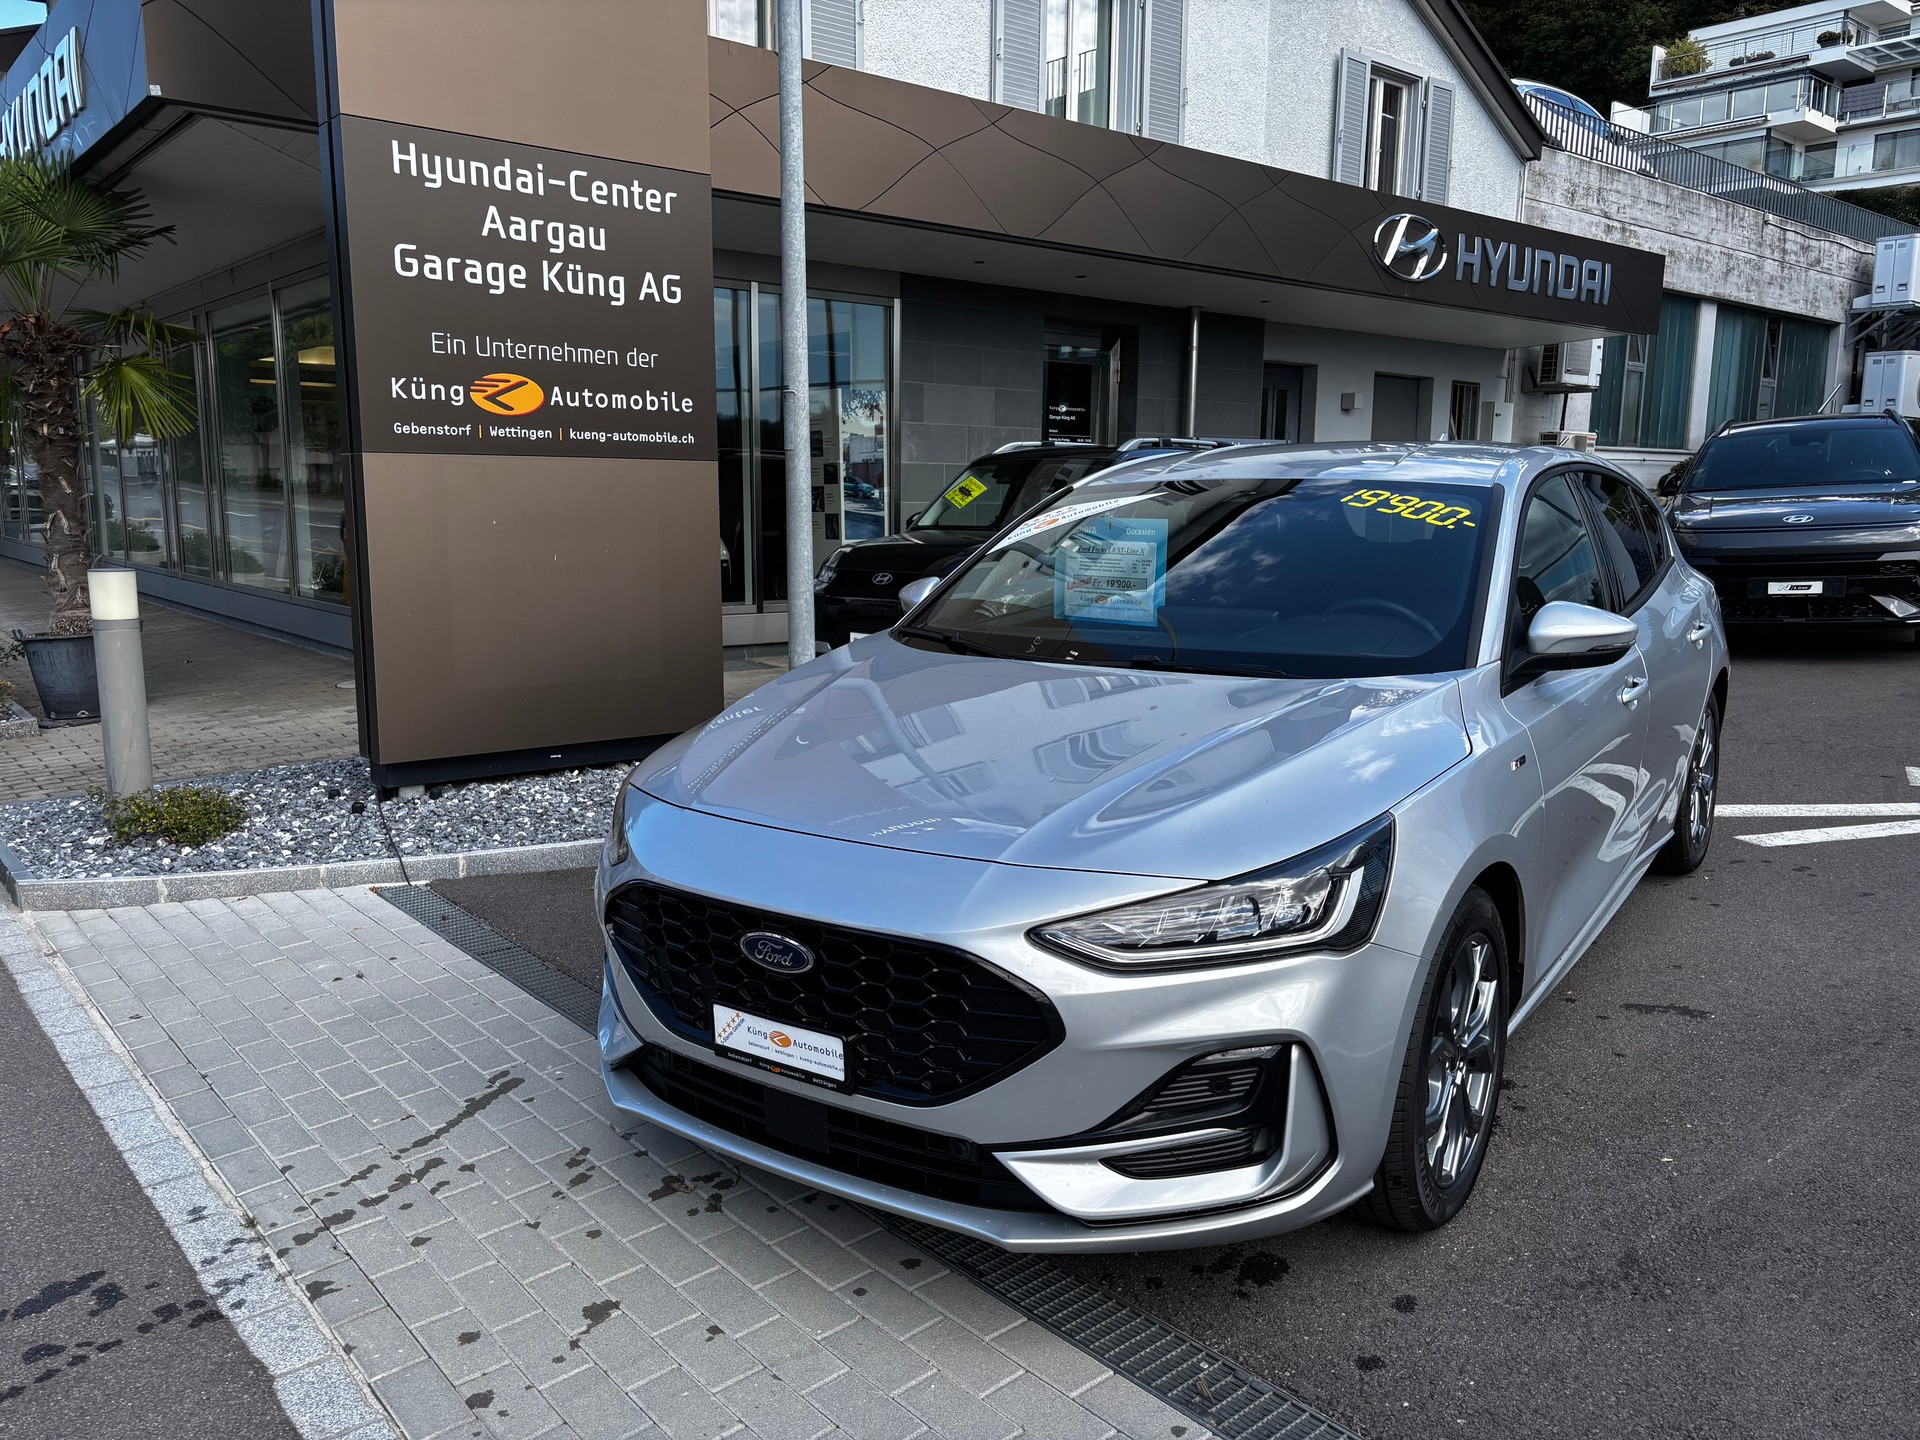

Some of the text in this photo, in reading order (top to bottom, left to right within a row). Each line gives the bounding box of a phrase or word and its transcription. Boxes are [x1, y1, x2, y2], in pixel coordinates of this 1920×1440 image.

[391, 139, 678, 214] Hyundai-Center
[481, 205, 606, 254] Aargau
[394, 243, 682, 307] Garage Küng AG
[1455, 233, 1612, 306] HYUNDAI
[431, 331, 658, 368] Ein Unternehmen der
[390, 376, 694, 413] Küng Automobile
[393, 422, 695, 444] Gebenstorf Wettingen kueng-automobile.ch
[1340, 489, 1476, 529] 19'900.-
[1126, 527, 1156, 536] Occasion
[1092, 578, 1103, 588] Fr.
[754, 940, 794, 967] Ford
[746, 1025, 844, 1060] Küng Automobile
[748, 1040, 770, 1051] Gebenstorf
[774, 1049, 795, 1059] Wettingen
[727, 1052, 838, 1089] Gebenstorf Küng Automobile Wettingen
